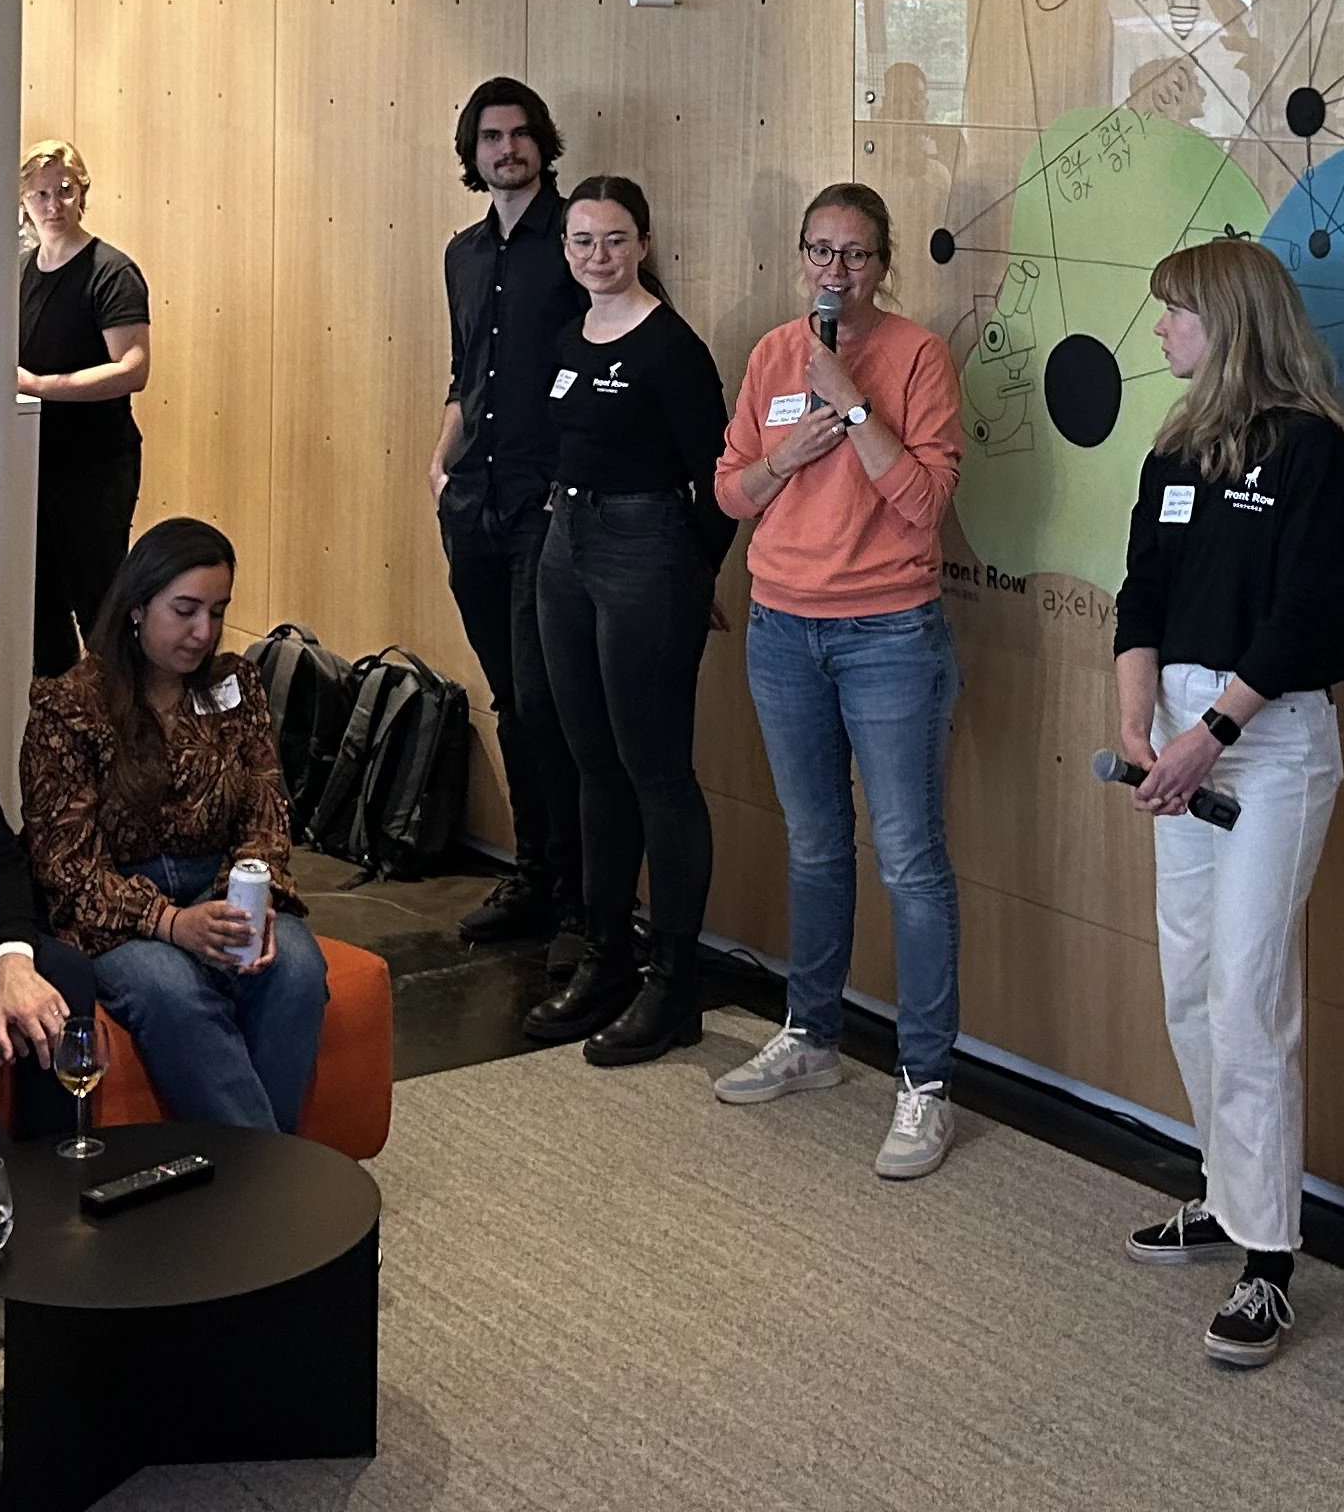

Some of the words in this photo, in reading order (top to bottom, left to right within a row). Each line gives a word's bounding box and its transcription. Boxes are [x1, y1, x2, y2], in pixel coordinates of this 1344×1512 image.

[1223, 489, 1250, 502] Front
[1251, 492, 1275, 506] Row
[941, 561, 981, 586] ront
[986, 565, 1027, 595] Row
